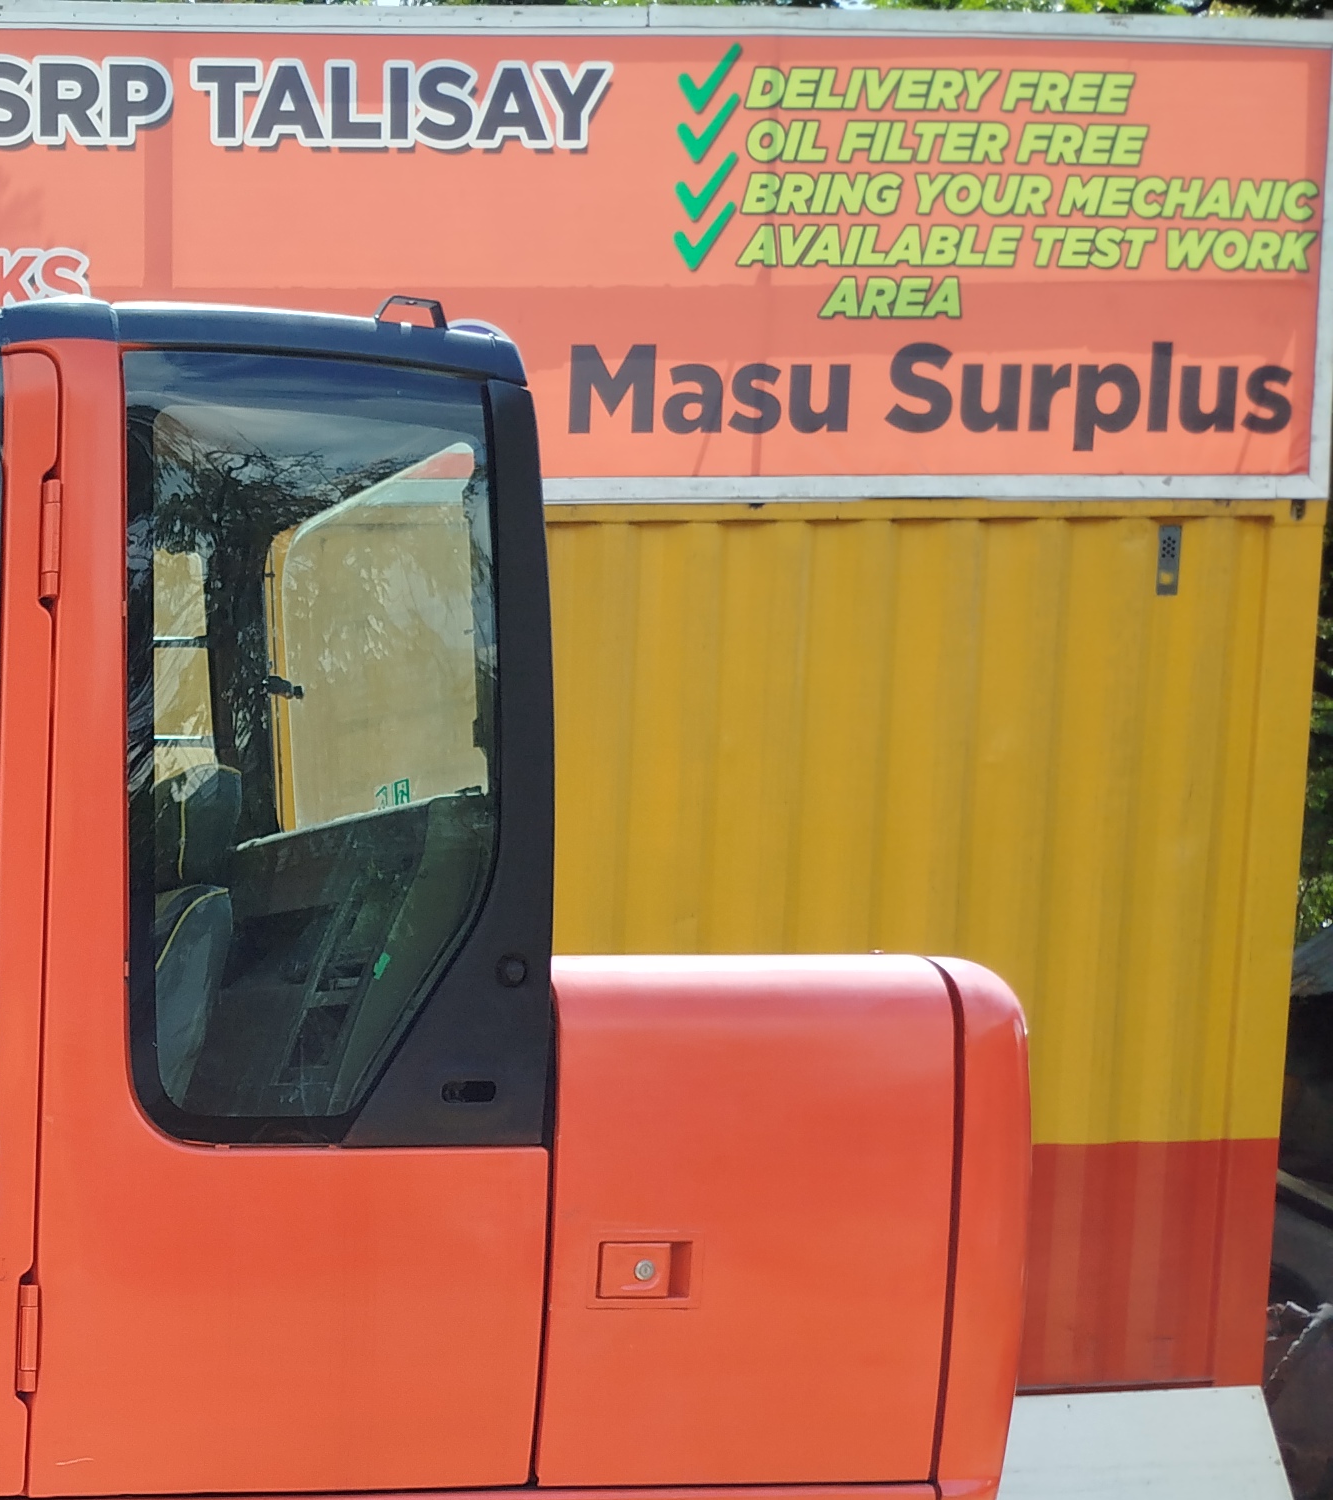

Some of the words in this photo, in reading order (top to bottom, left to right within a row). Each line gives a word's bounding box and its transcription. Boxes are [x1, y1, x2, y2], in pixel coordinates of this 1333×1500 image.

[191, 58, 613, 149] TALISAY
[744, 66, 1001, 112] DELIVERY
[1002, 70, 1134, 115] FREE
[746, 120, 827, 163] OIL
[838, 121, 1014, 164] FILTER
[1016, 125, 1149, 166] FREE
[741, 173, 901, 215] BRING
[914, 175, 1054, 217] YOUR
[1057, 174, 1319, 222] MECHANIC
[738, 224, 1022, 267] AVAILABLE
[1033, 226, 1157, 270] TEST
[1166, 228, 1318, 272] WORK
[819, 276, 962, 319] AREA
[567, 344, 851, 435] Masu
[883, 341, 1293, 452] Surplus
